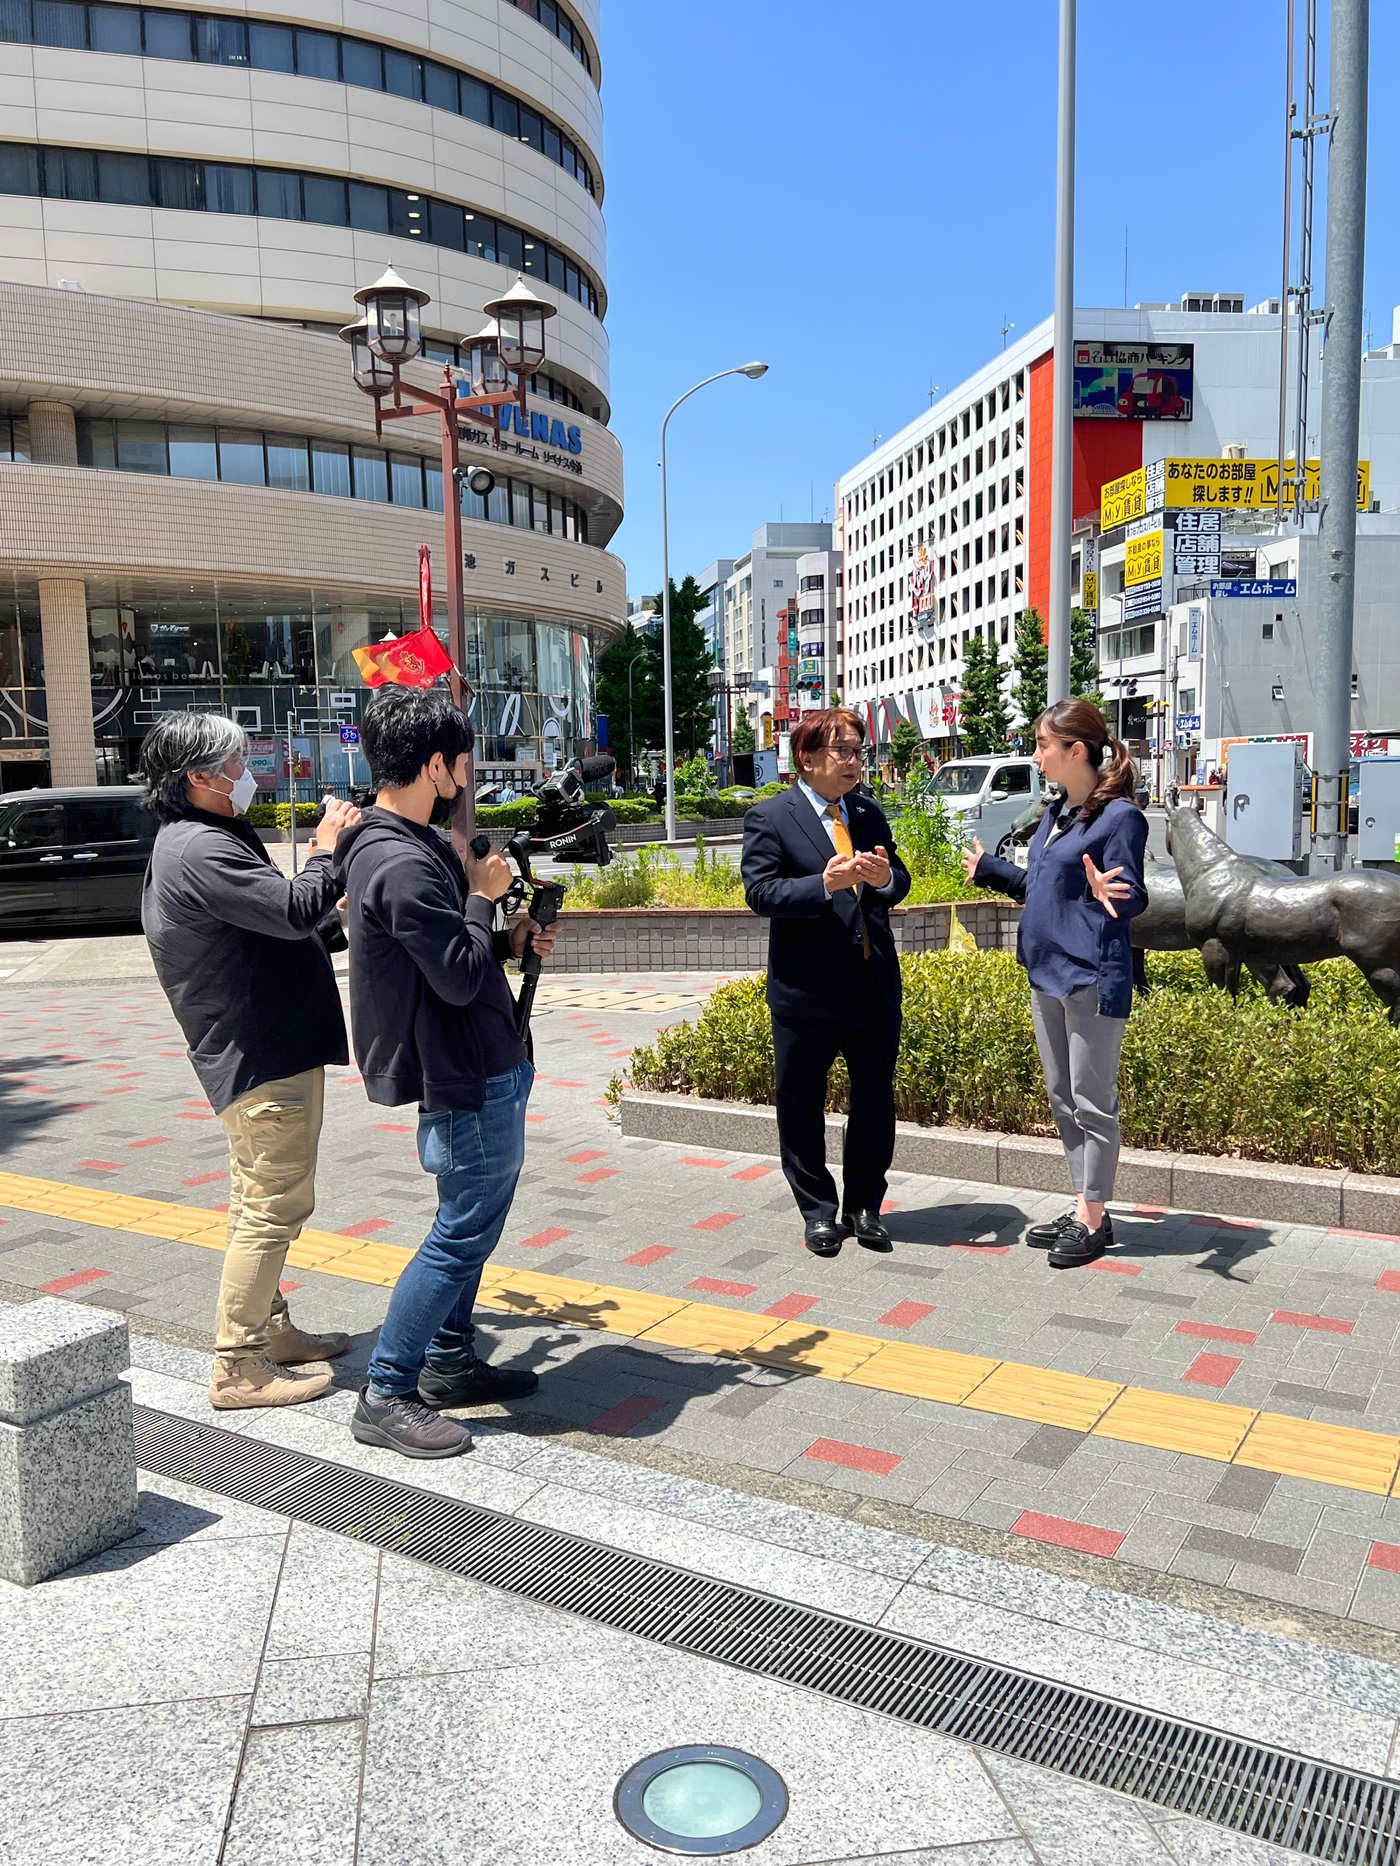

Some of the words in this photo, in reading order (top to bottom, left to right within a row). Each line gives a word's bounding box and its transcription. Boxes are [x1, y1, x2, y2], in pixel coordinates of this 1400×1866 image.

[1168, 463, 1256, 481] あなたのお部屋
[1104, 472, 1143, 499] お部屋探しなら
[1192, 485, 1254, 504] 探します!!
[1175, 513, 1220, 532] 住居
[1175, 535, 1220, 553] 店舗
[464, 552, 603, 593] 池ガスビル
[1175, 555, 1220, 574] 管理
[1240, 582, 1296, 594] エムホーム
[549, 834, 577, 849] RONIN
